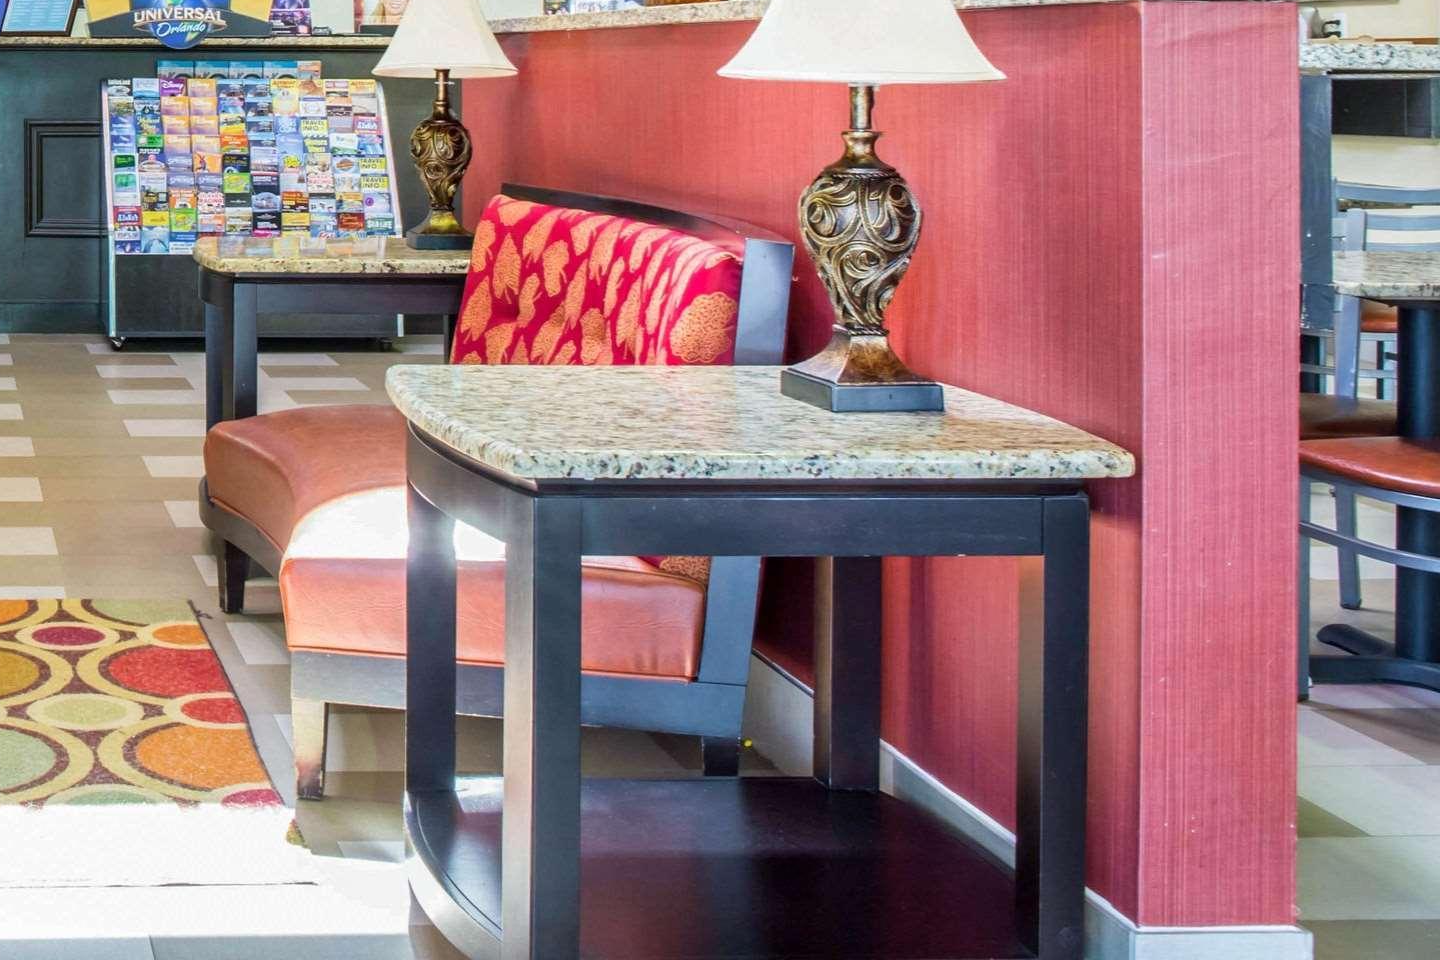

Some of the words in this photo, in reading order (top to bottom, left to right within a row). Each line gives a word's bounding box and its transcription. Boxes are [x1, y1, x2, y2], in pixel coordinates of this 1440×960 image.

[134, 7, 226, 24] UNIVERSAL
[156, 21, 206, 37] Orlando
[161, 80, 184, 90] Disney
